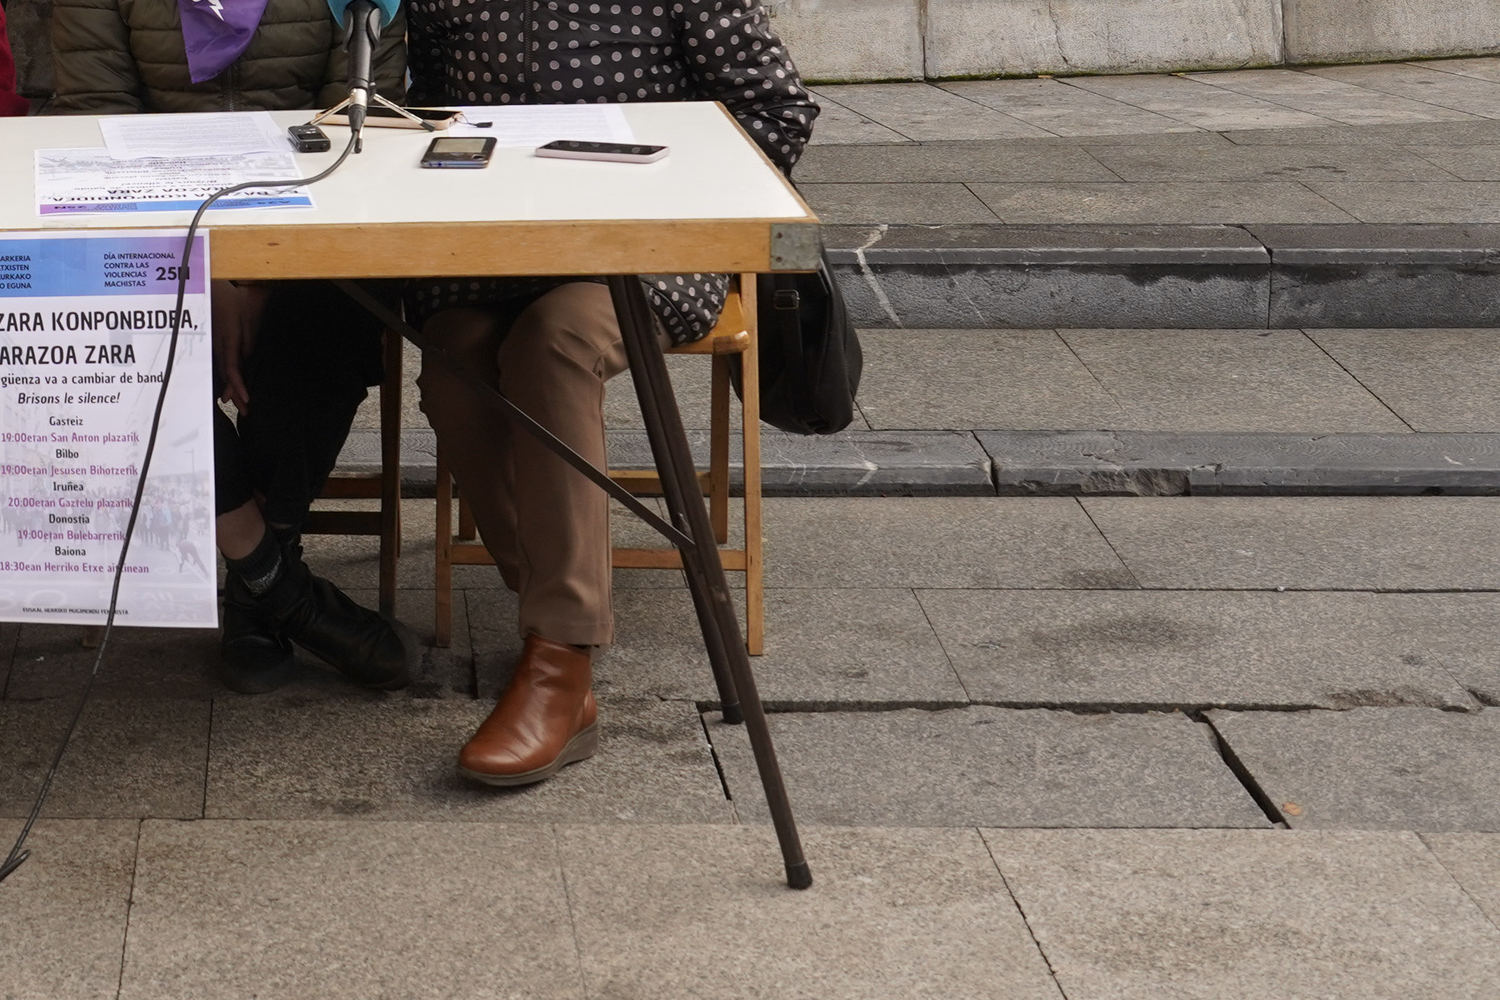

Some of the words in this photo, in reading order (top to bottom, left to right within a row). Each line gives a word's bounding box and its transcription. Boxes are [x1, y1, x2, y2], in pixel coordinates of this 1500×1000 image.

[104, 252, 116, 260] DÍA
[52, 309, 198, 331] KONPONBIDEA,
[0, 346, 77, 365] ARAZOA
[85, 344, 136, 364] ZARA
[45, 376, 57, 385] va
[61, 376, 68, 385] a
[72, 373, 116, 385] cambiar
[120, 372, 133, 384] de
[137, 372, 164, 384] band
[18, 393, 60, 405] Brisons
[64, 393, 74, 404] le
[78, 393, 120, 404] silence!
[49, 416, 83, 426] Gasteiz
[1, 433, 48, 443] 19:00etan
[51, 433, 68, 443] San
[71, 433, 100, 443] Anton
[103, 433, 139, 445] plazatik
[56, 449, 79, 459] Bilbo
[1, 465, 47, 475] 19:00etan
[50, 465, 87, 477] Jesusen
[90, 465, 138, 476] Bihotzetik
[53, 481, 84, 492] Iruñea
[8, 497, 56, 508] 20:00etan
[59, 498, 94, 508] Gaztelu
[97, 498, 134, 509] plazatik
[49, 514, 90, 524] Donostia
[18, 530, 64, 540] 19:00etan
[67, 530, 126, 541] Bulebarretik
[54, 546, 86, 556] Baiona
[0, 561, 42, 572] 18:30ean
[44, 562, 79, 572] Herriko
[82, 563, 104, 572] Etxe
[107, 563, 149, 573] aitinean
